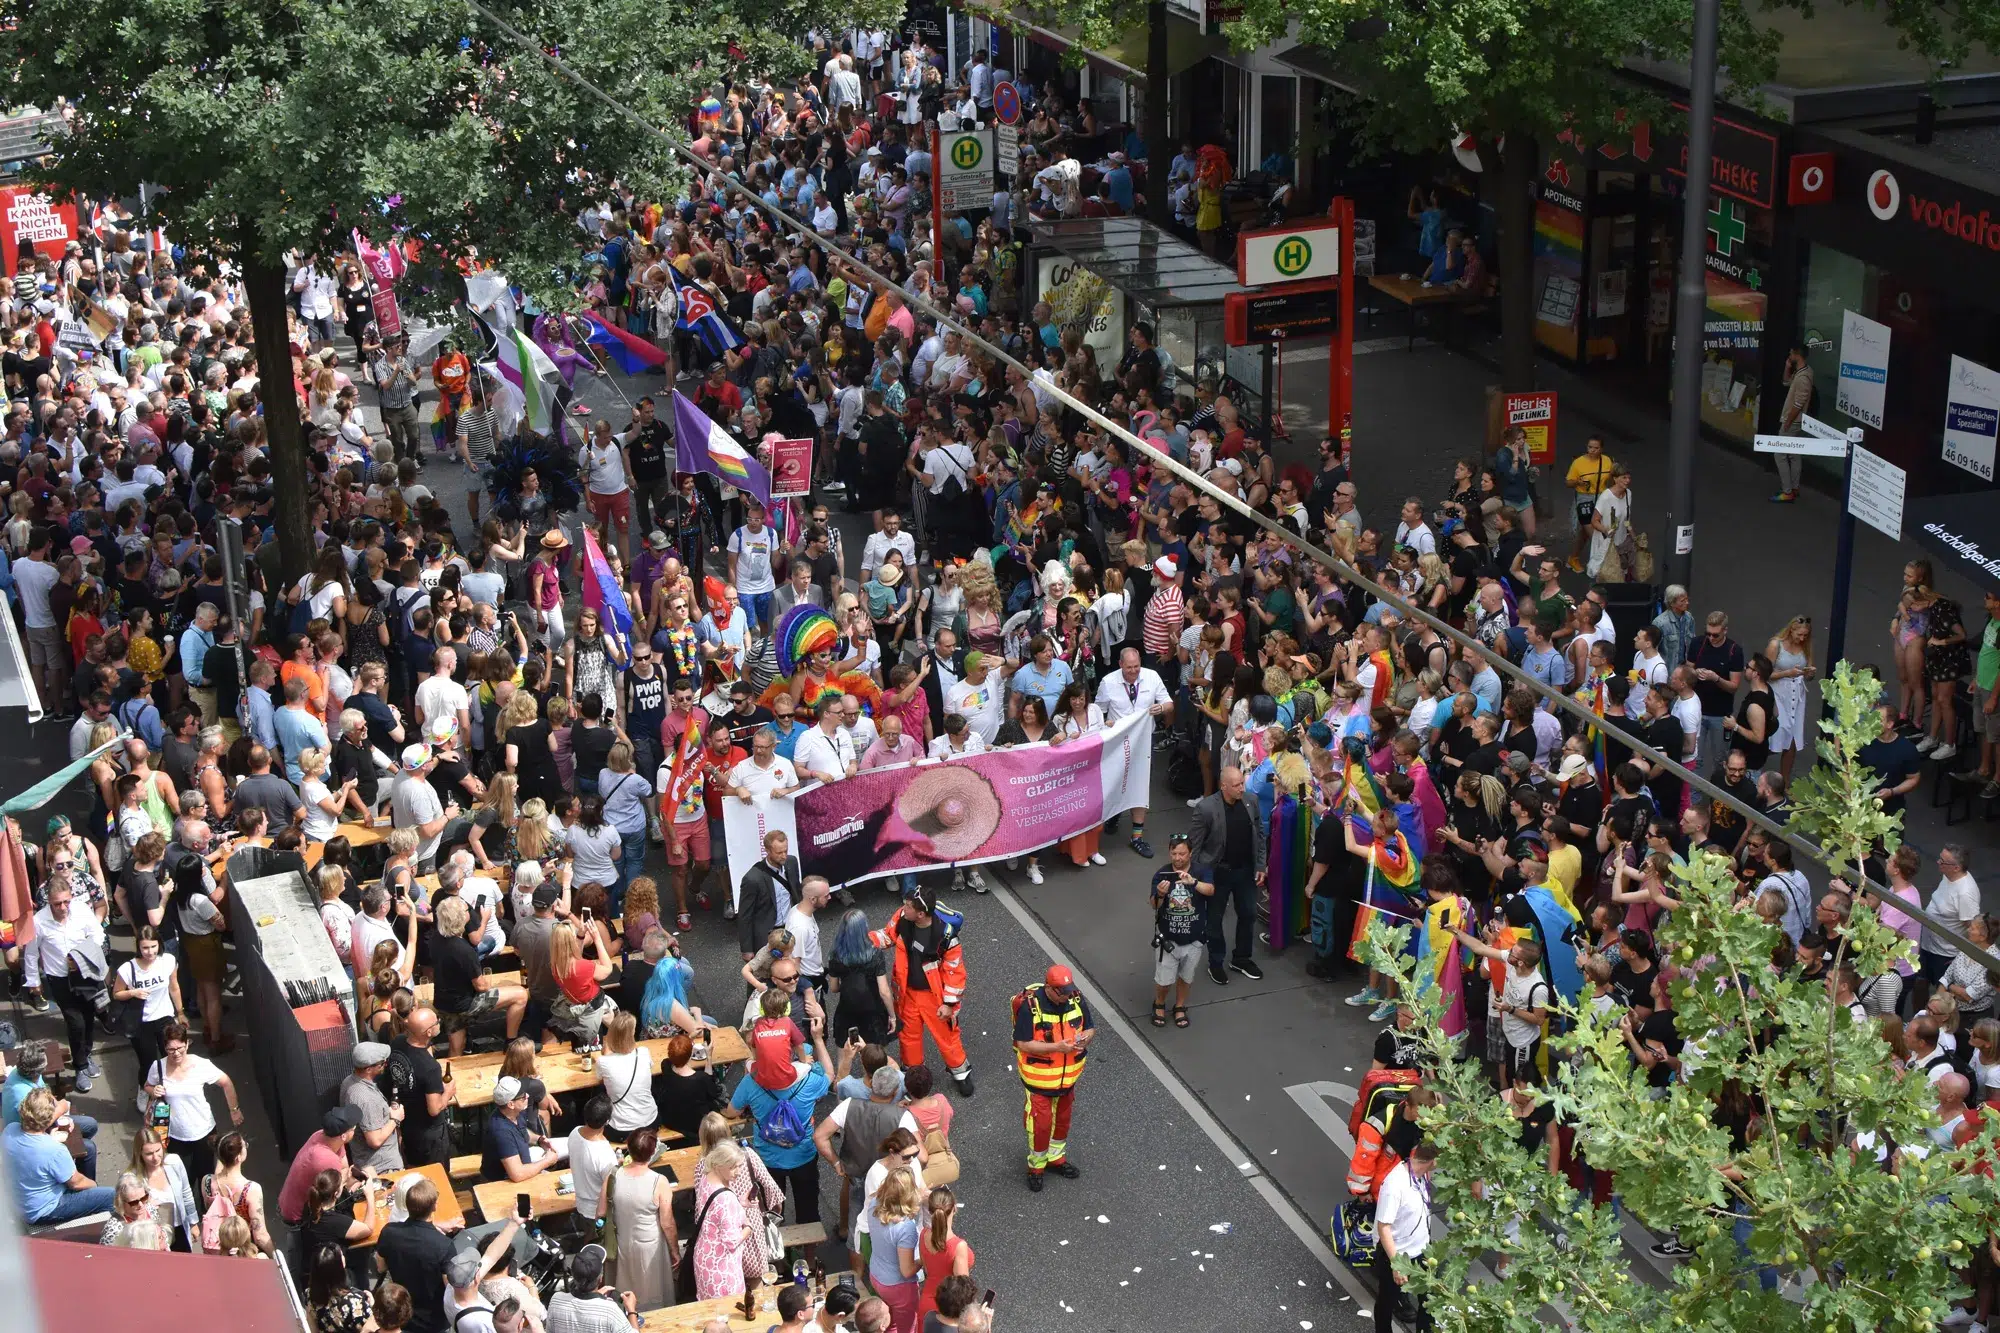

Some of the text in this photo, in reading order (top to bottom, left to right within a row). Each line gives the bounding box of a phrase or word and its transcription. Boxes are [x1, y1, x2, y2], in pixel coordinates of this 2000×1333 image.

[1681, 144, 1760, 194] ATHEKE
[1544, 188, 1582, 212] APOTHEKE
[10, 208, 48, 219] KANN
[20, 217, 58, 230] NICHT
[17, 228, 66, 241] FEIERN.
[1705, 254, 1743, 279] HARMACY
[1749, 337, 1759, 348] Uhr
[1842, 365, 1885, 382] Zu vermieten
[1508, 397, 1551, 410] Hier ist
[1513, 411, 1524, 421] DIE
[1838, 399, 1881, 427] 46 09 16 46
[1949, 406, 1997, 422] Ihr Ladenflächen-
[1957, 418, 1986, 431] Spezialist!
[1767, 440, 1805, 449] Außenalster
[1945, 449, 1991, 478] 46 09 16 46
[423, 578, 440, 586] FCS
[635, 680, 662, 697] PWR
[640, 695, 662, 710] TOP
[1009, 760, 1089, 785] GRUNDSÄTZLICH
[1026, 773, 1075, 798] GLEICH
[1011, 786, 1089, 817] FÜR EINE BESSERE
[1015, 798, 1087, 829] VERFASSUNG
